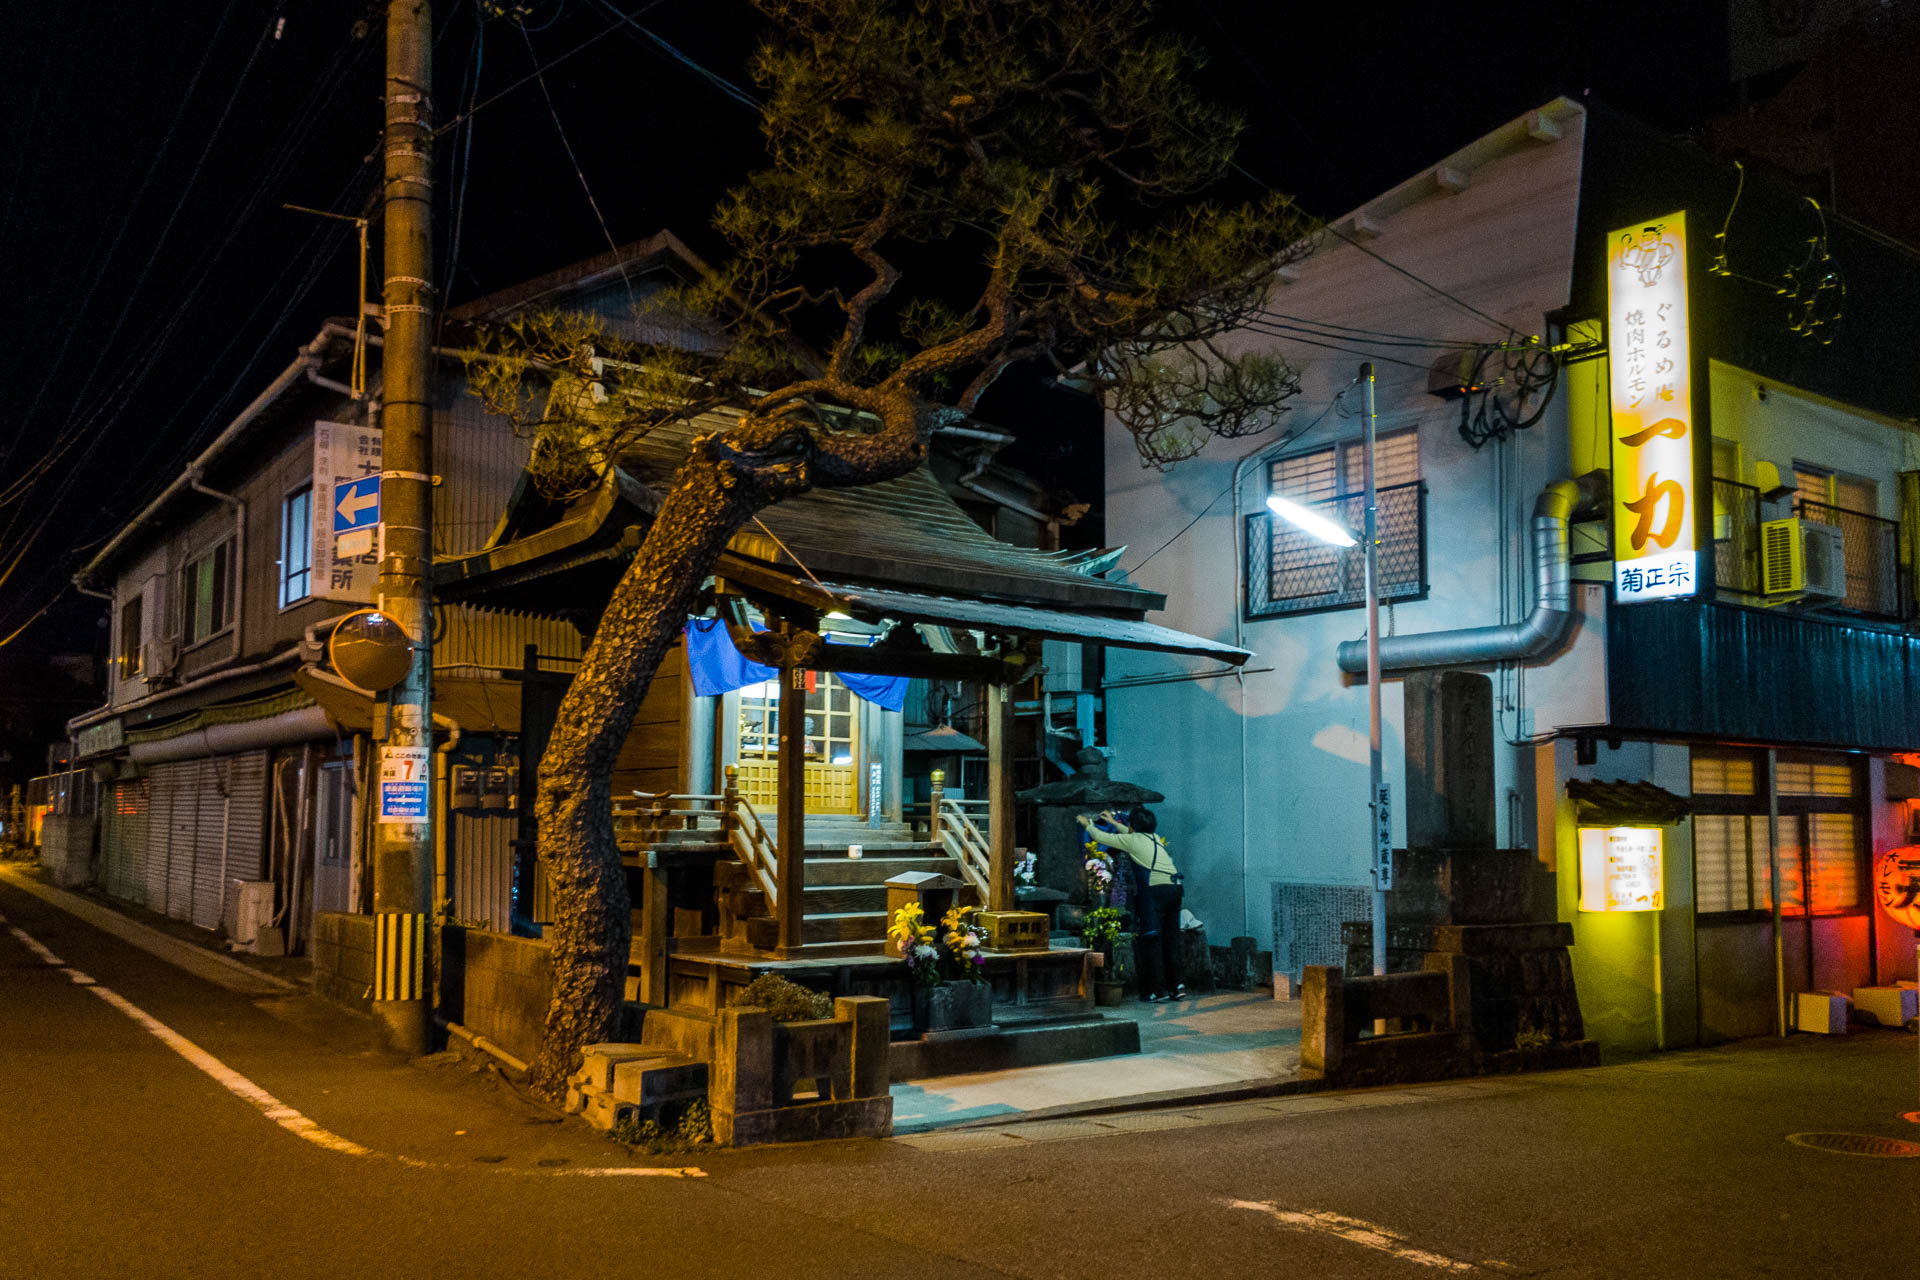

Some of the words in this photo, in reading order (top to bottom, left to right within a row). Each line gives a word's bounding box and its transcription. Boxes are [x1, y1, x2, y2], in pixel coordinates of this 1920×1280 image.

[1624, 308, 1648, 409] 焼肉ホルモン
[1617, 416, 1689, 552] 一力
[1620, 561, 1691, 593] 菊正宗
[1879, 851, 1900, 907] ホルモン
